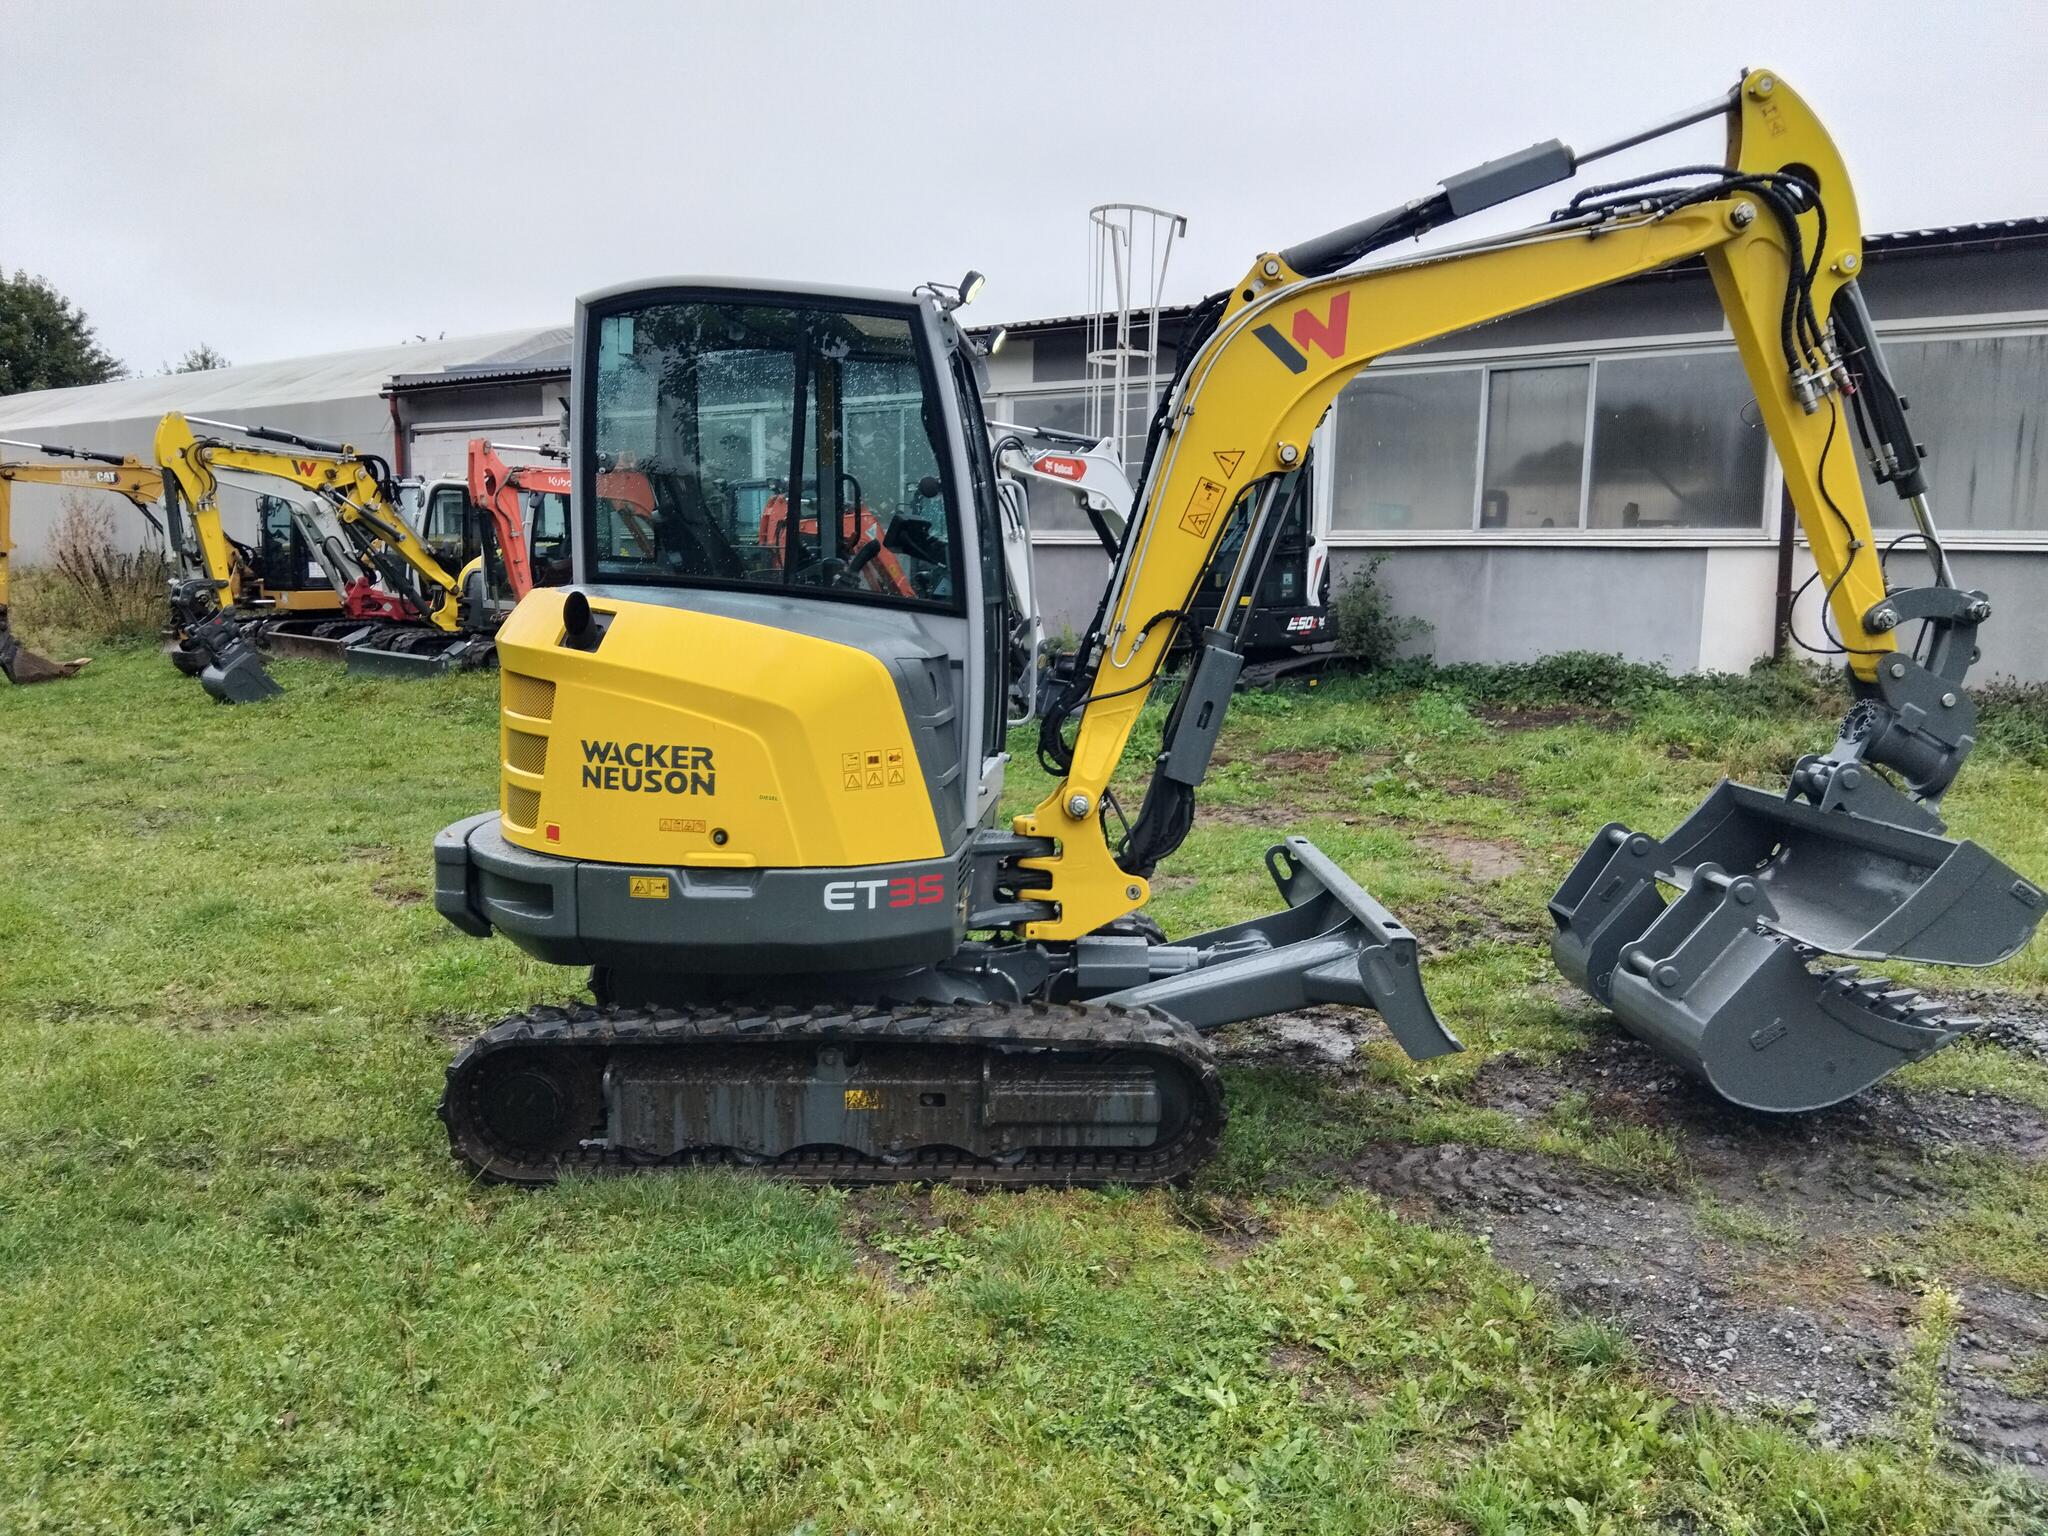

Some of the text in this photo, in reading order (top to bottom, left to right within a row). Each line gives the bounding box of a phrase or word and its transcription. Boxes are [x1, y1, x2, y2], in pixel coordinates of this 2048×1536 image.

[96, 471, 116, 482] CAT
[1054, 462, 1073, 475] Bobcat
[580, 739, 716, 771] WACKER
[582, 764, 716, 796] NEUSON
[823, 874, 944, 910] ET35
